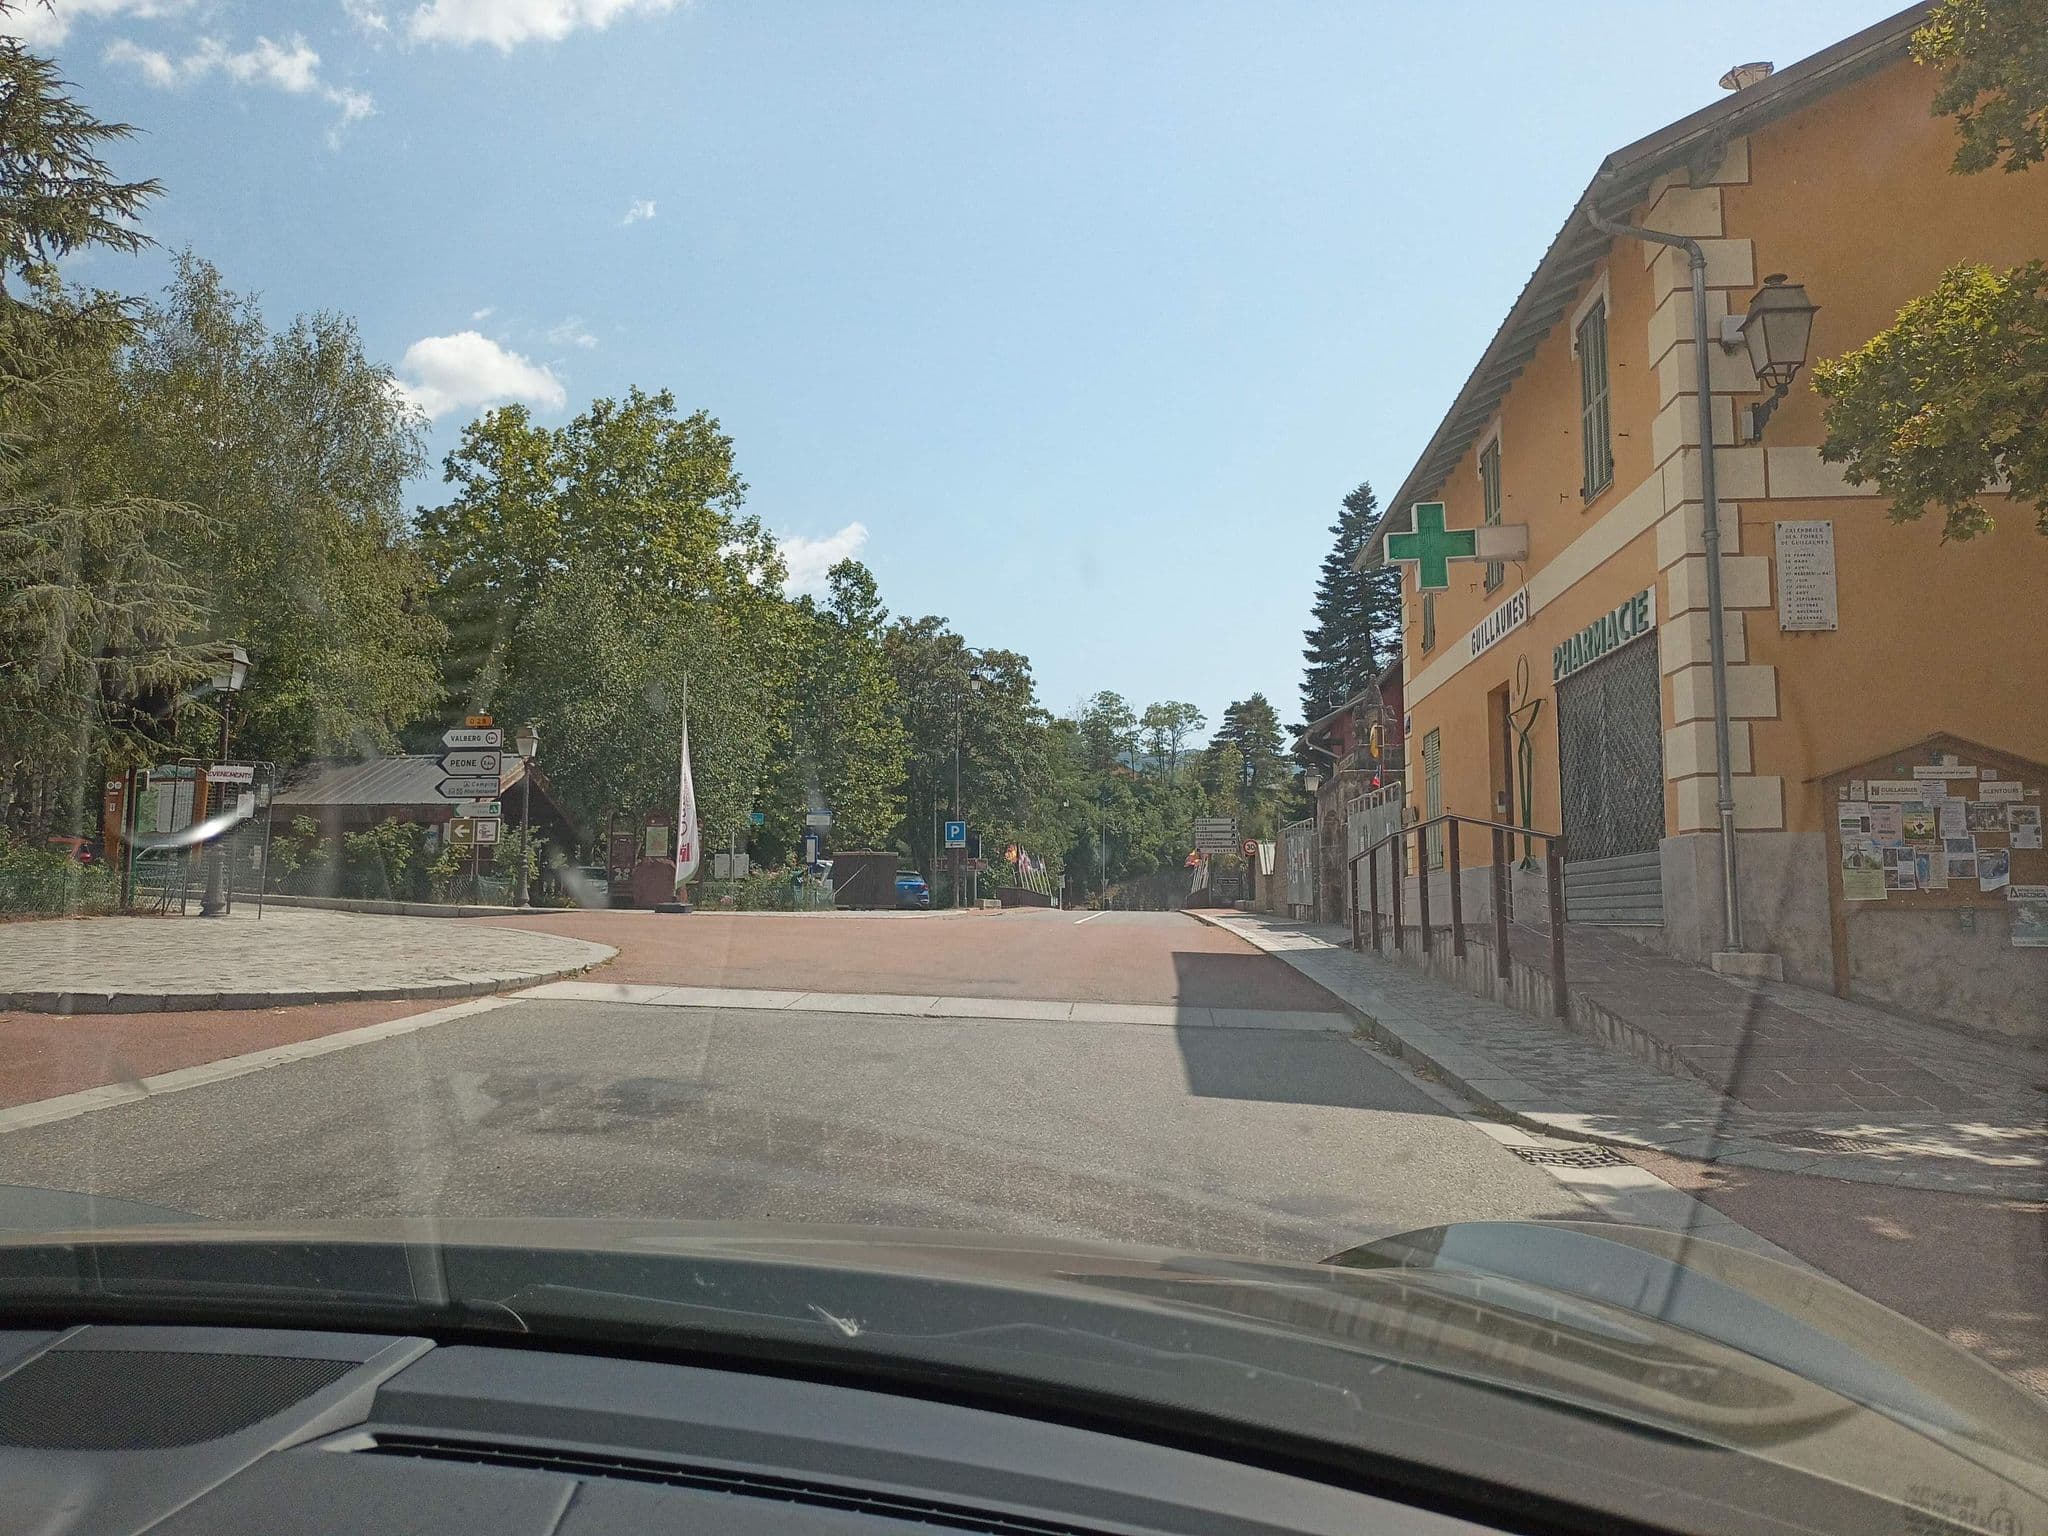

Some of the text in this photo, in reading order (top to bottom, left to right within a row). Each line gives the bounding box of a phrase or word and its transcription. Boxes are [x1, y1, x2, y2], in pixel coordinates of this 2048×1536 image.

[1471, 591, 1524, 656] GUILLAUMES
[1552, 589, 1649, 681] PHARMACIE
[450, 759, 477, 767] PEONE
[1247, 843, 1256, 851] 30
